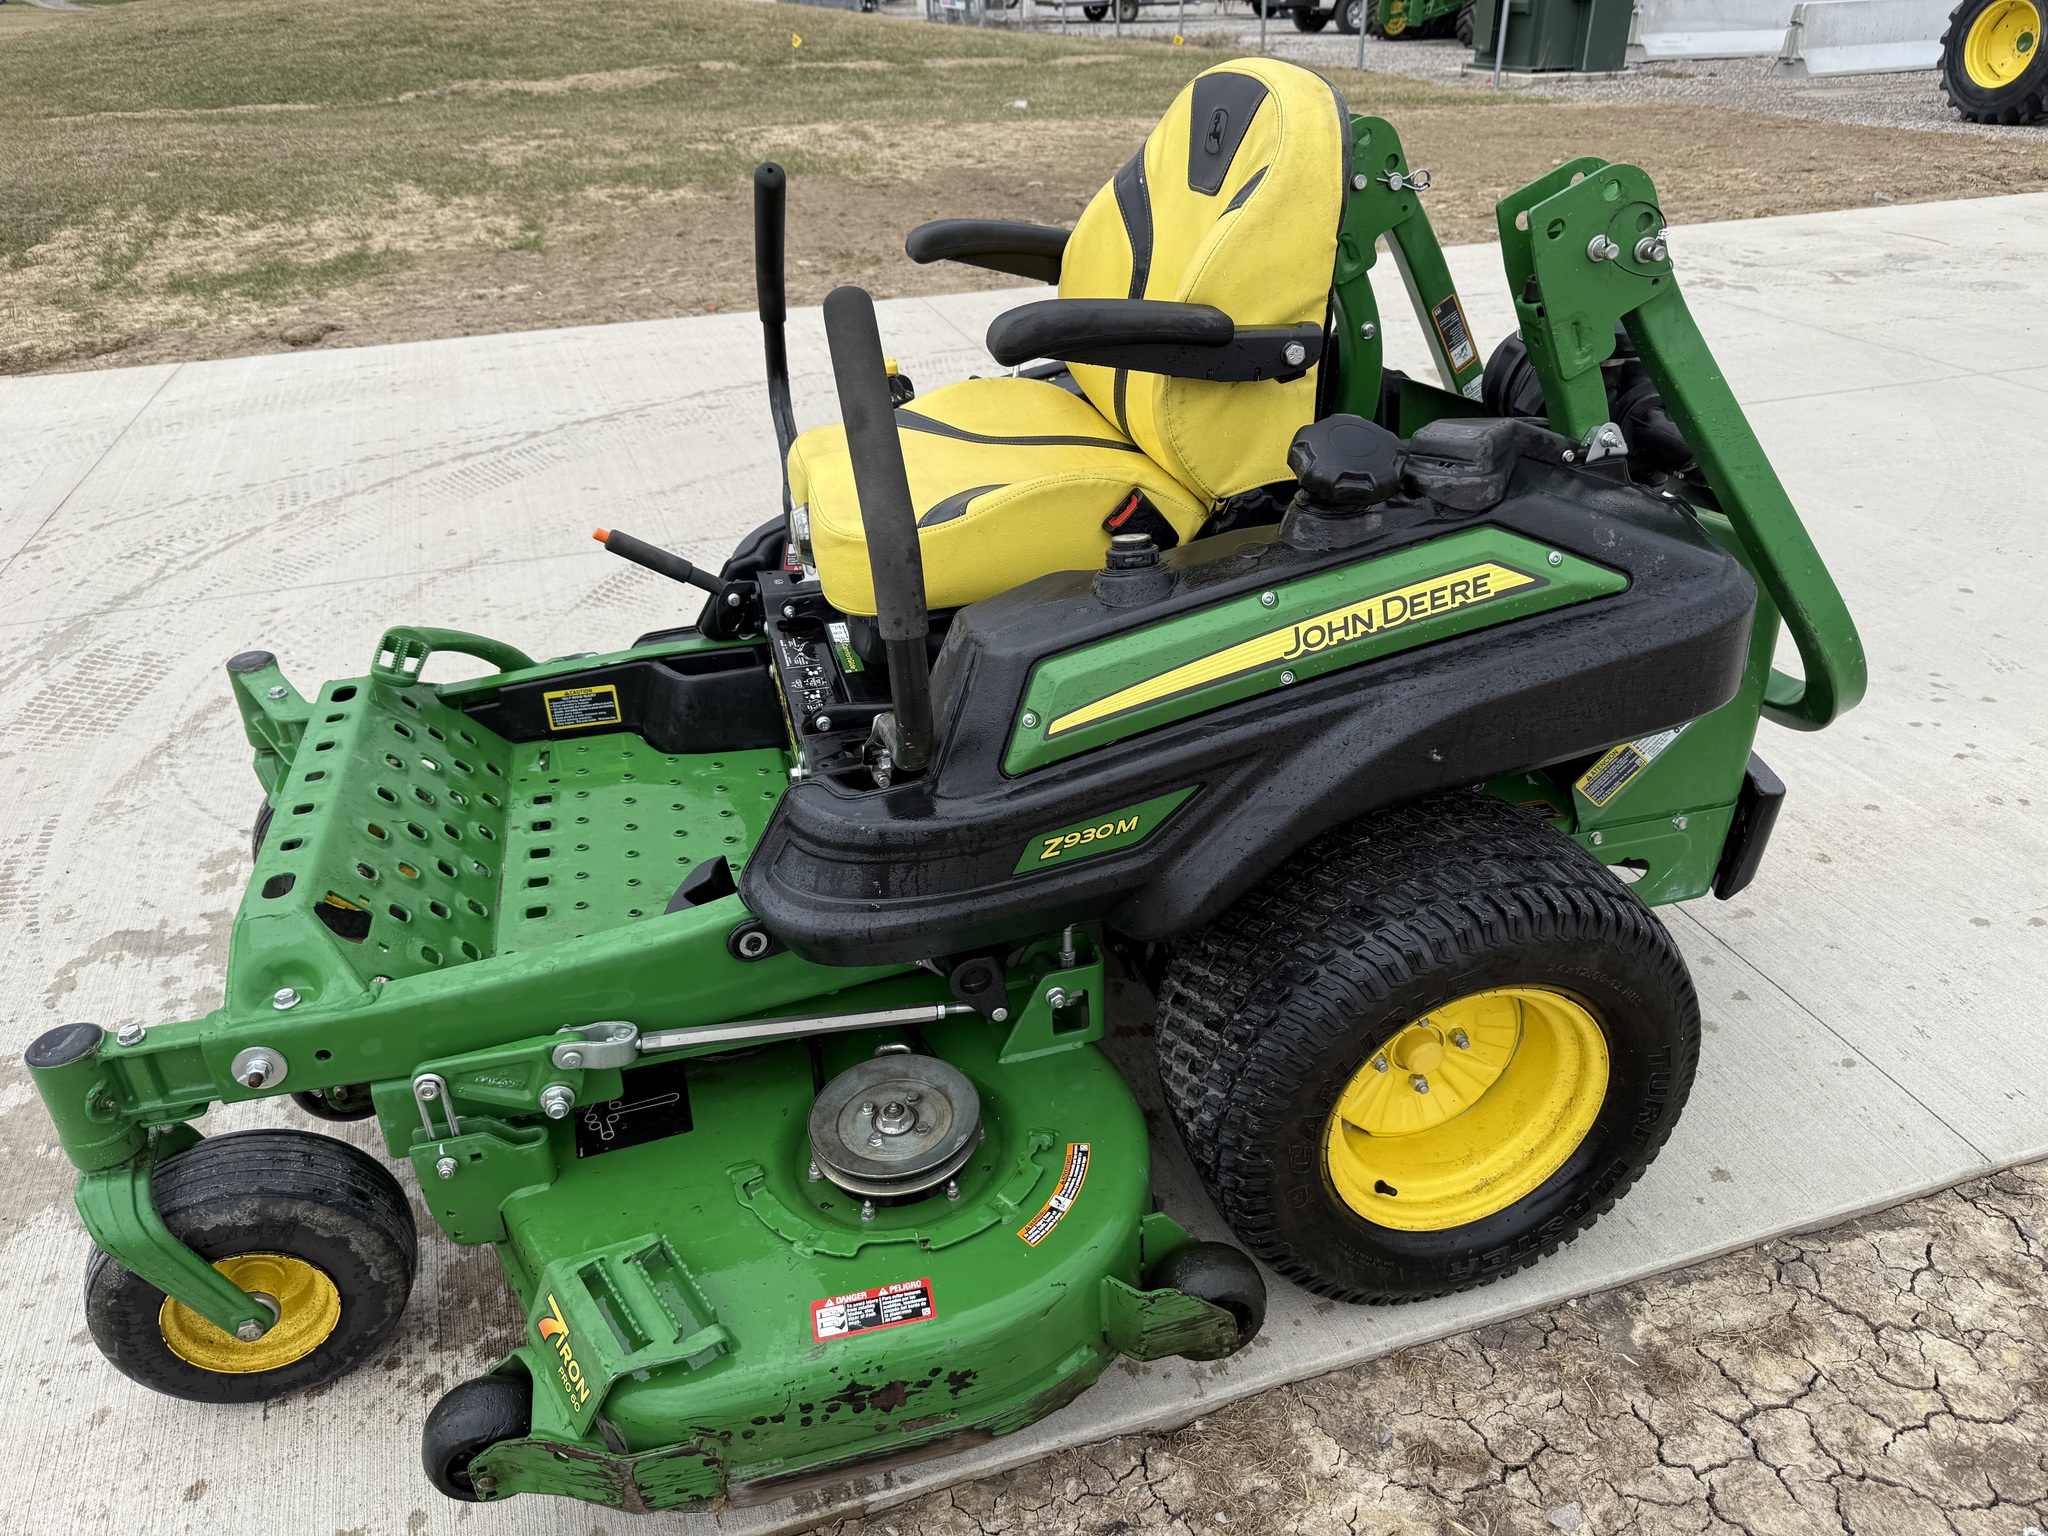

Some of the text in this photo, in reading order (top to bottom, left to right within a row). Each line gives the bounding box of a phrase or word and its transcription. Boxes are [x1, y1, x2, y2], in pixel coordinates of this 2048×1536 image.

[1283, 573, 1491, 657] JOHN DEERE
[1591, 749, 1619, 777] ATENCION
[1040, 815, 1139, 860] Z930M
[1288, 969, 1480, 1173] CARLISLE
[1449, 1044, 1671, 1280] TURF MASTER
[836, 1291, 868, 1304] DANGER
[889, 1279, 922, 1293] PELIGRO
[558, 1366, 580, 1413] PRO 60
